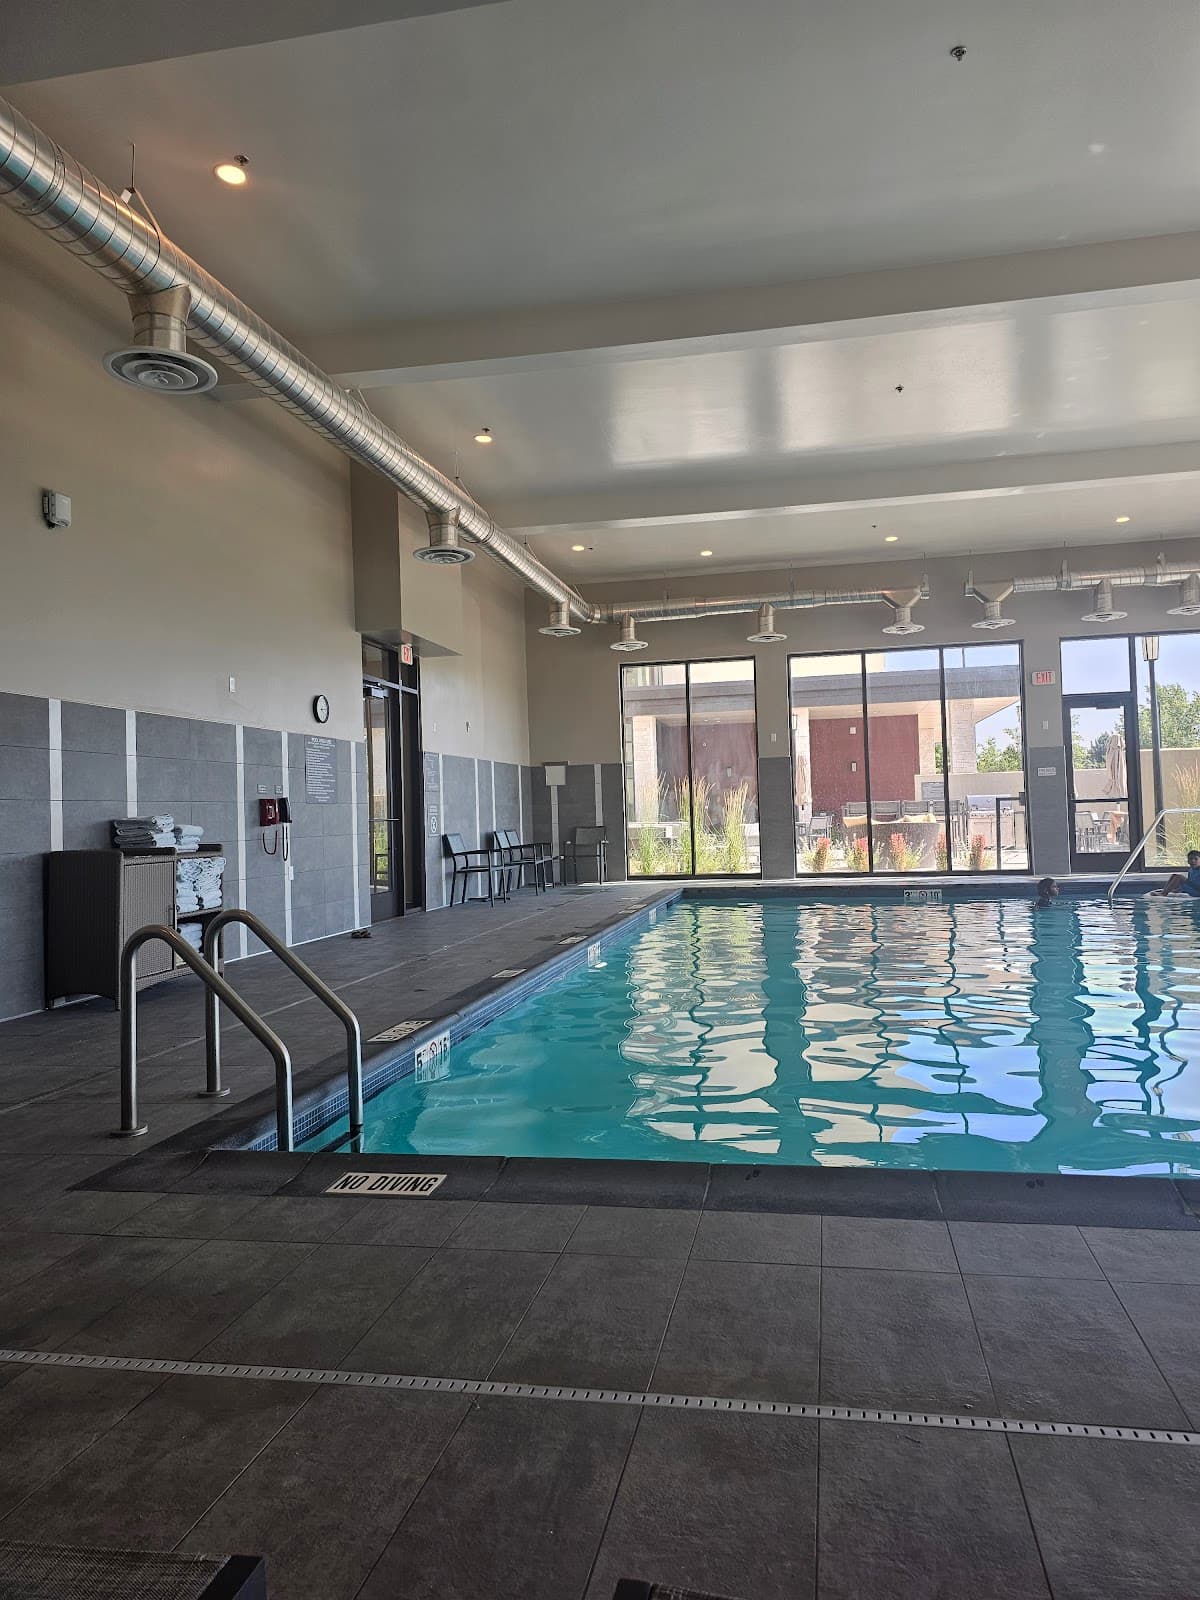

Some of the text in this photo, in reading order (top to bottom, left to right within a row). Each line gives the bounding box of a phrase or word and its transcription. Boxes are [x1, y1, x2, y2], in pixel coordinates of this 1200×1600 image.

[1036, 671, 1052, 684] EXIT
[333, 1175, 439, 1192] NO DIVING
